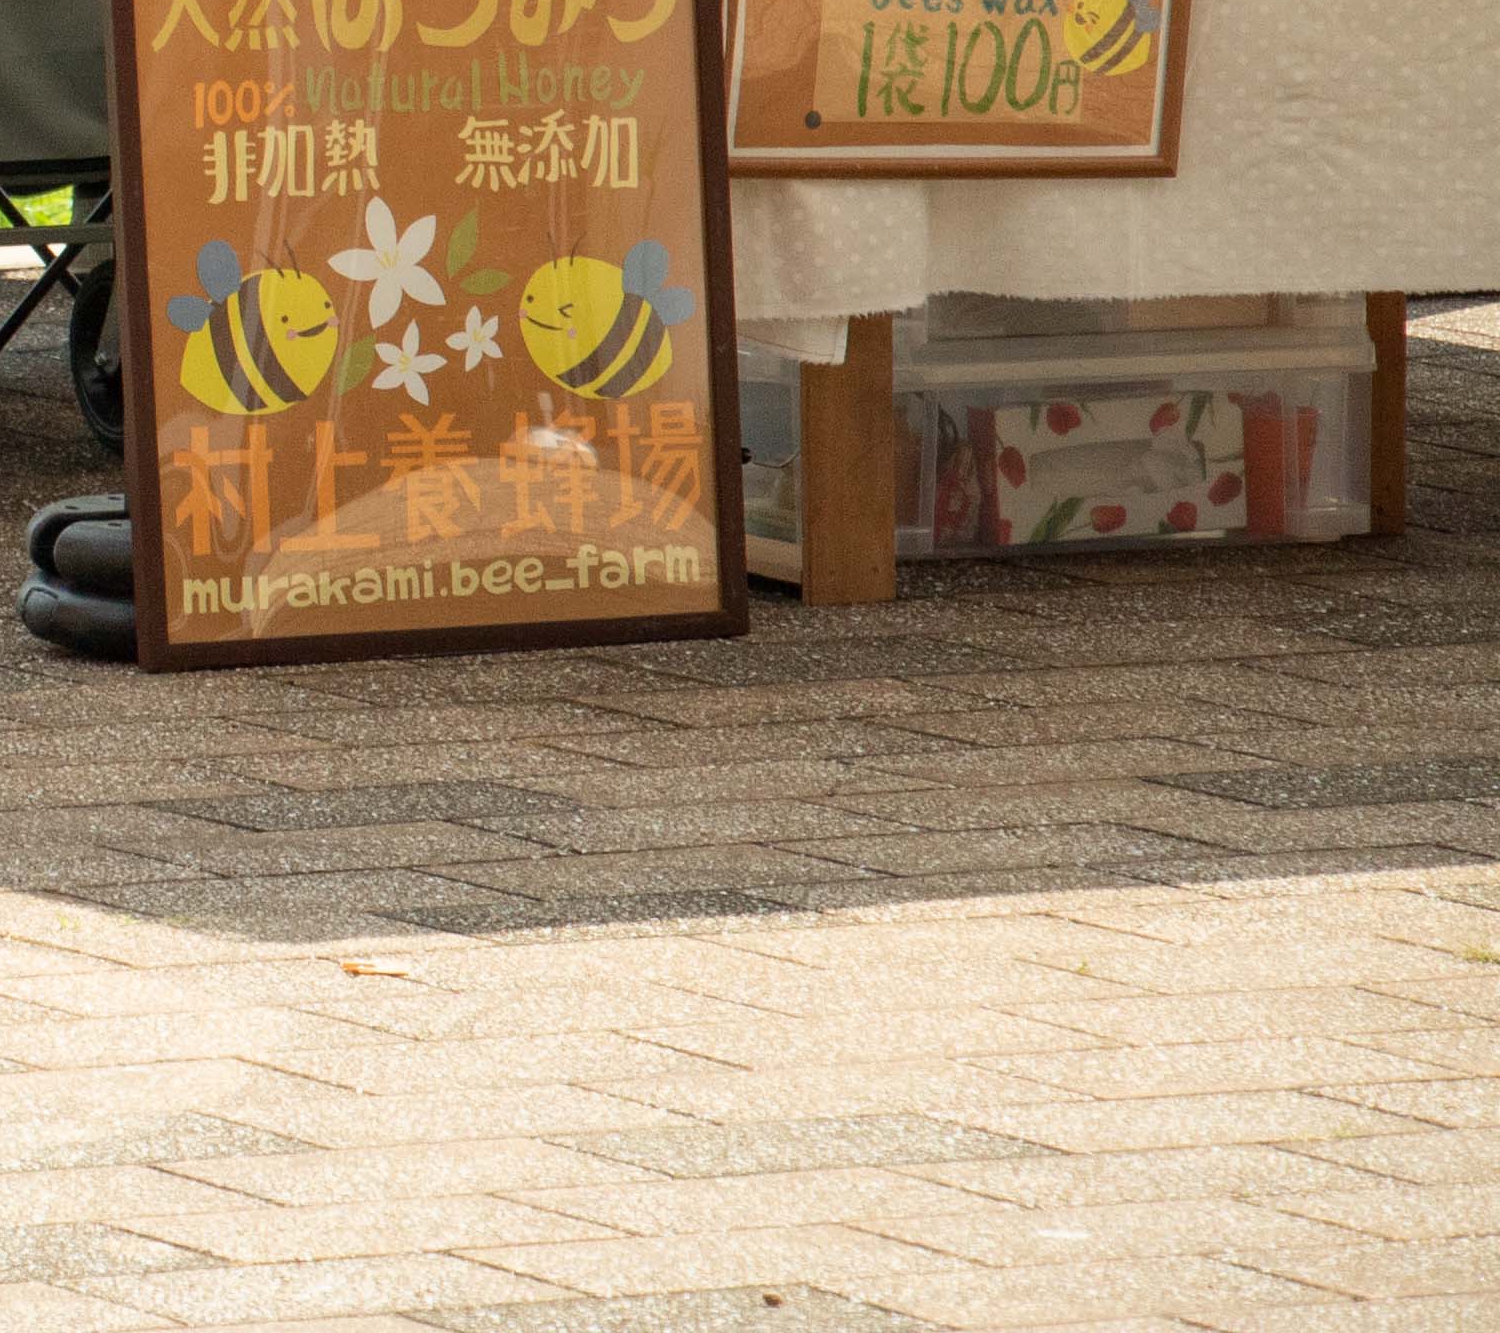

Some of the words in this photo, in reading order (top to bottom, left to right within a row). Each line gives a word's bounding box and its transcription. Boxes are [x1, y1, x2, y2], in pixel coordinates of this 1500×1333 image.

[193, 79, 297, 127] 100%
[499, 50, 645, 111] Honey
[202, 119, 381, 204] 非加熱
[455, 109, 639, 192] 無添加
[166, 400, 704, 558] 村上養蜂場
[182, 542, 700, 615] murakami.bee_farm
